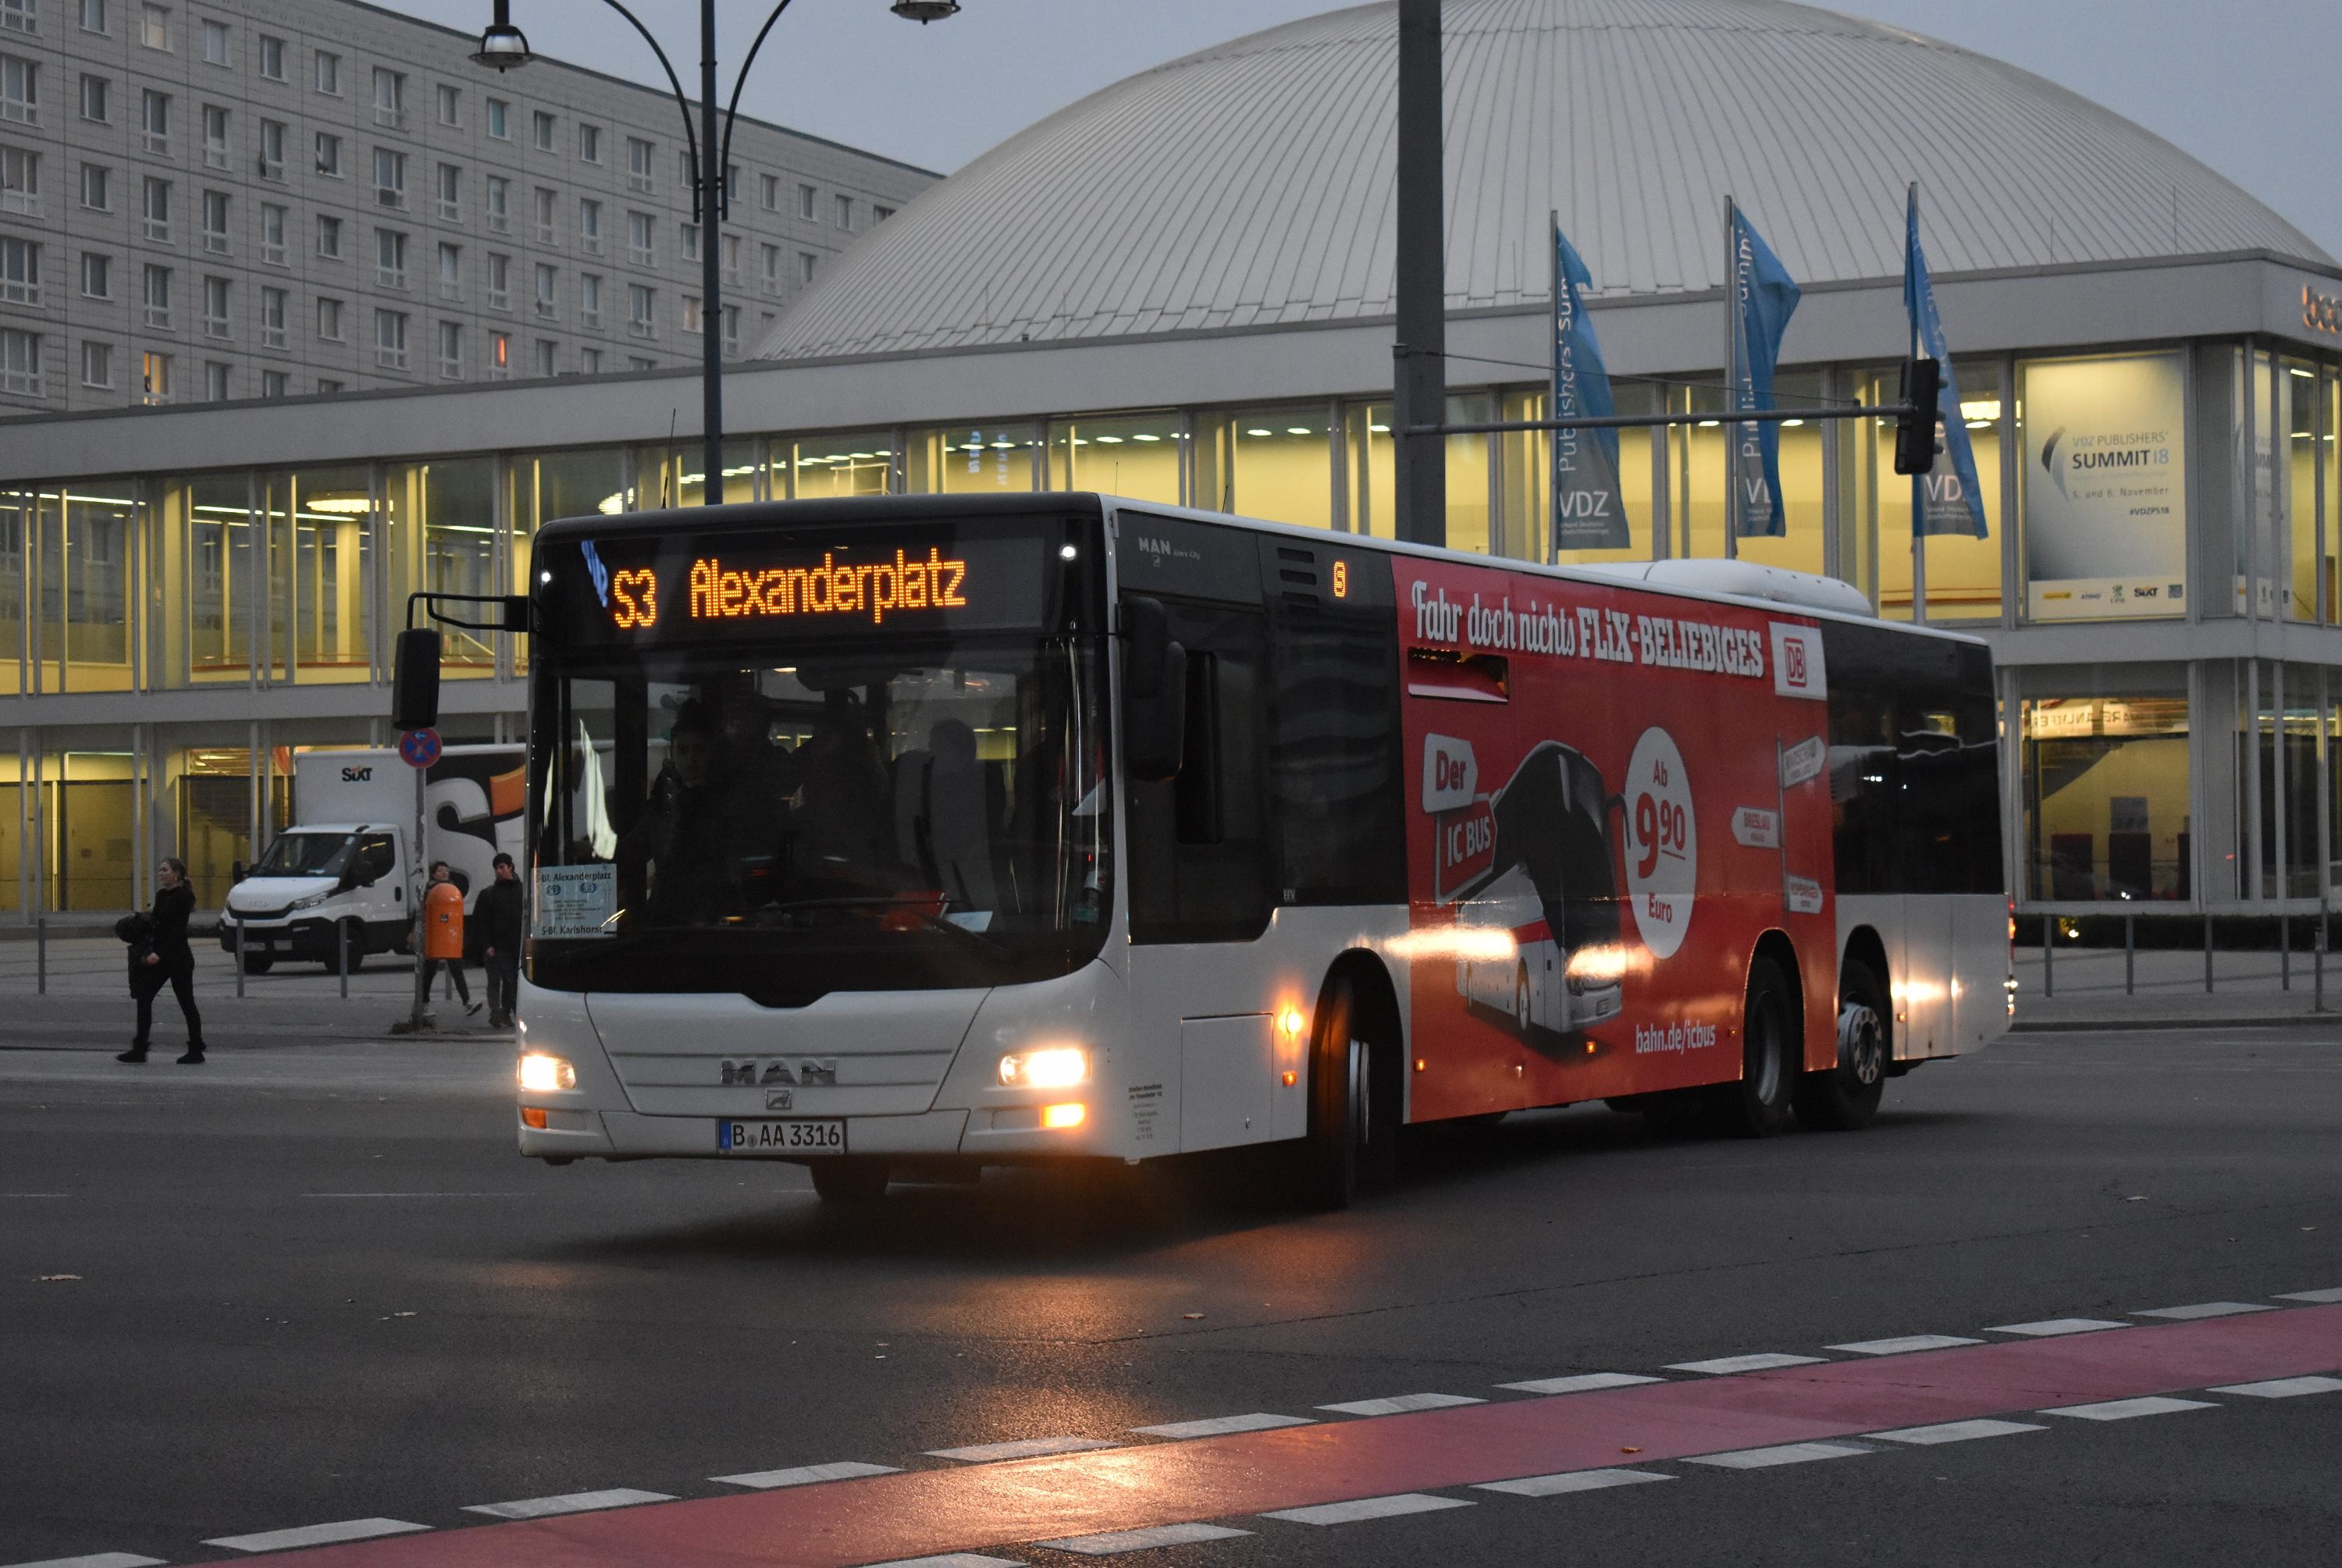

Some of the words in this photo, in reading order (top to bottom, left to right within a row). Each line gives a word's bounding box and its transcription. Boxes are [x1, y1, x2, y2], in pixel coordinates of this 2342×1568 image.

[1559, 340, 1577, 471] Pubishers'
[2072, 450, 2151, 470] SUMMIT
[1924, 475, 1965, 502] VD
[2120, 485, 2169, 497] November
[1559, 490, 1611, 518] VDZ
[1137, 536, 1171, 556] MAN
[614, 568, 657, 628] S3
[690, 547, 966, 624] Alexanderplatz
[1411, 580, 1463, 643] Fahr
[1467, 592, 1517, 650] doch
[1519, 599, 1576, 657] nichts
[1786, 645, 1804, 680] DB
[1435, 749, 1467, 791] Der
[1653, 759, 1668, 788] Ab
[1447, 823, 1463, 868] IC
[1466, 816, 1491, 859] BUS
[553, 872, 612, 882] Alexanderplatz
[1648, 892, 1673, 924] Euro
[559, 925, 603, 935] Karlshorst
[1635, 1019, 1717, 1056] bahn.de/icbus
[721, 1058, 836, 1086] MAN
[732, 1124, 745, 1147] B
[760, 1124, 785, 1147] AA
[790, 1124, 841, 1147] 3316
